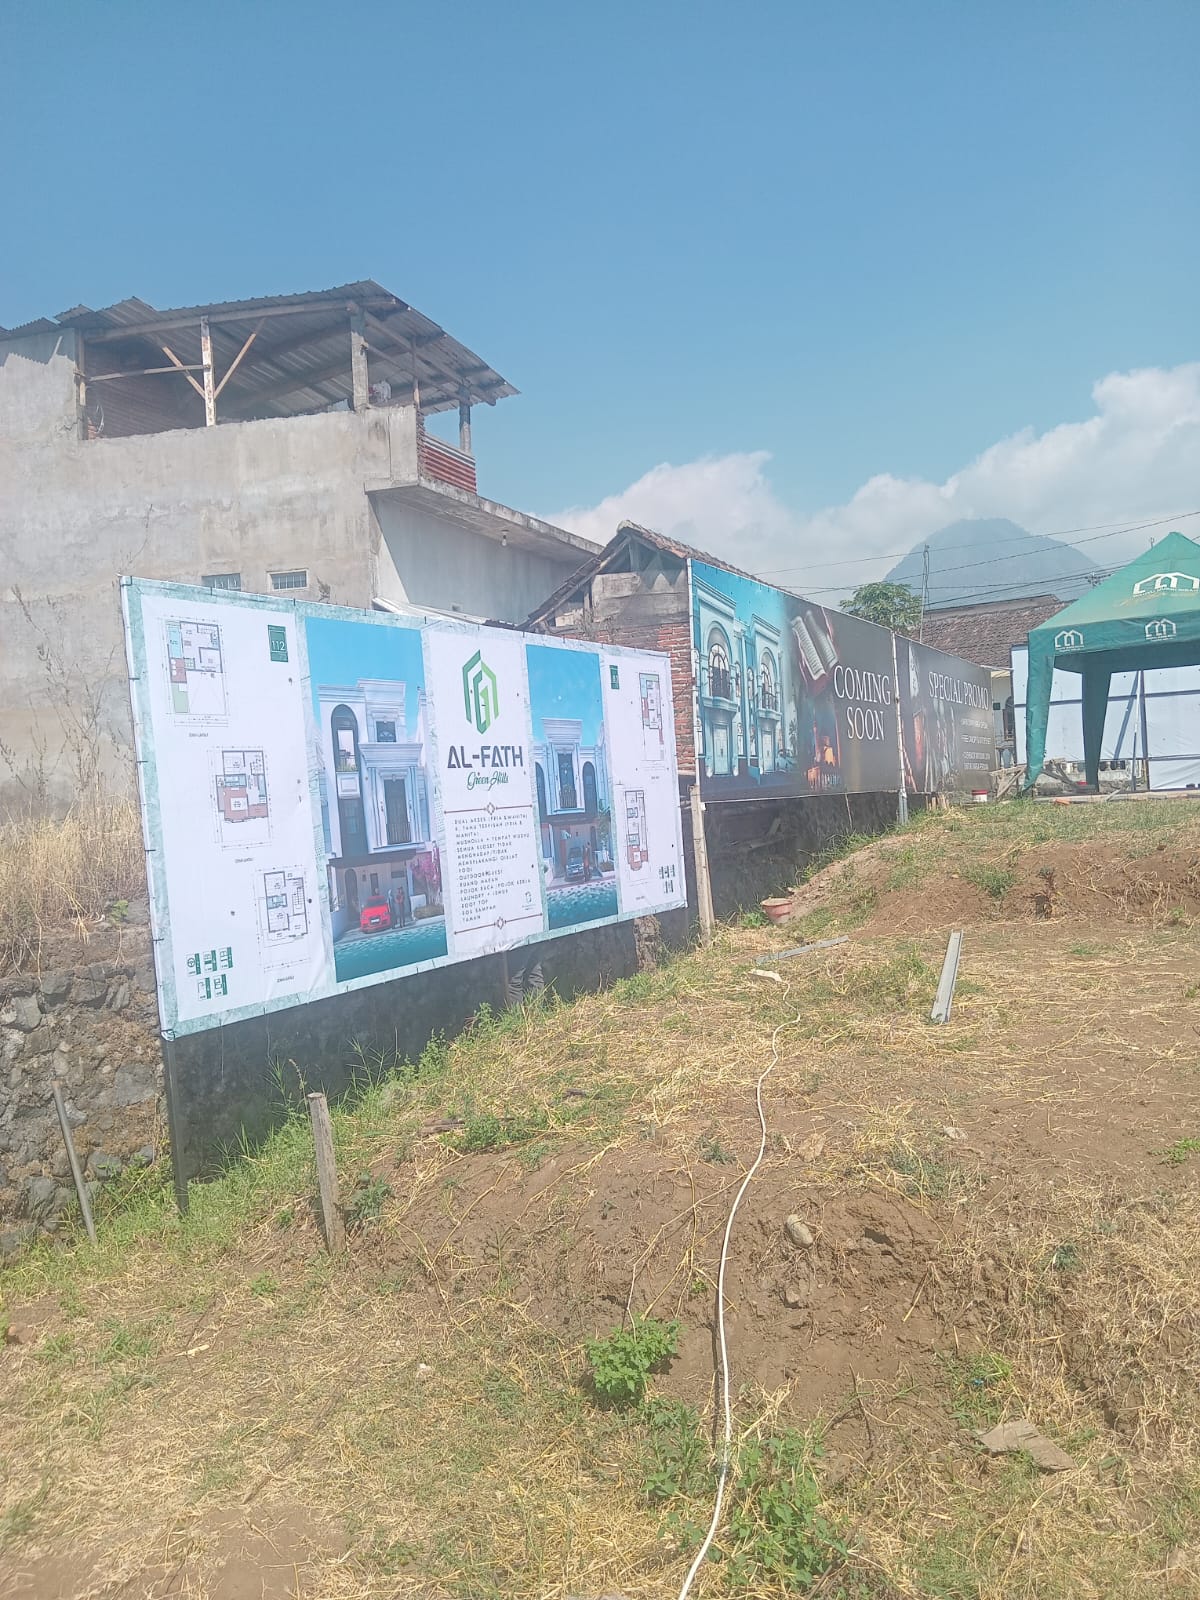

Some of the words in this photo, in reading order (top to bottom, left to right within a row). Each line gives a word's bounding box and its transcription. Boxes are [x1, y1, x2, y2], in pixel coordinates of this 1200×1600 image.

[271, 640, 286, 651] 112
[833, 665, 891, 705] COMING
[929, 671, 963, 704] SPECIAL
[963, 681, 990, 711] PROMO
[846, 706, 885, 741] SOON
[447, 745, 523, 768] AL-FATH
[467, 772, 489, 790] Green
[488, 771, 509, 791] Hills
